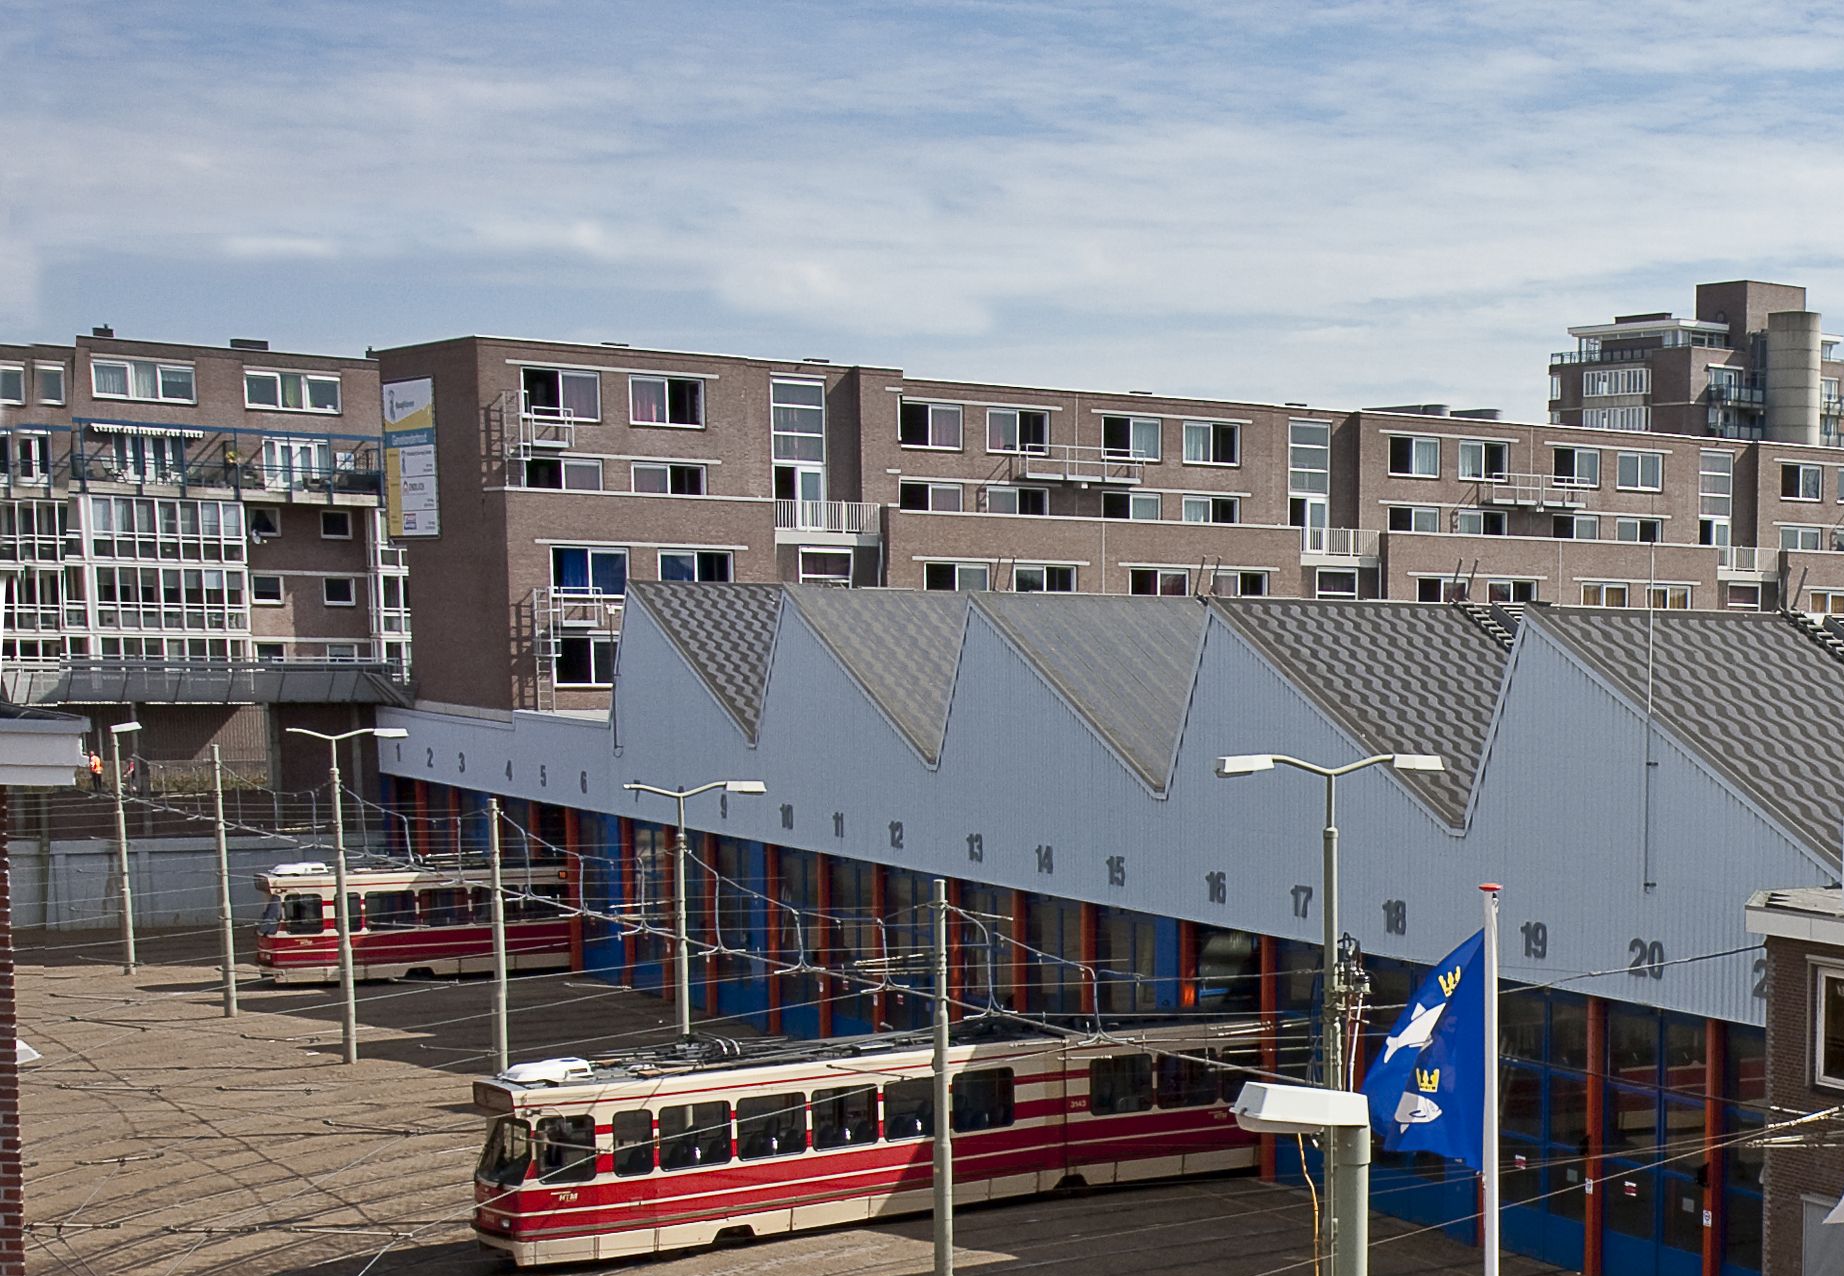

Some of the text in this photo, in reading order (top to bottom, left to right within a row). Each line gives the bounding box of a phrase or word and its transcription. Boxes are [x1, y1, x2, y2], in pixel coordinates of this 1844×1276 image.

[396, 743, 401, 762] 1
[426, 747, 434, 768] 2
[458, 752, 466, 773] 3
[505, 760, 513, 781] 4
[540, 765, 547, 787] 5
[580, 771, 588, 794] 6
[720, 793, 728, 819] 9
[779, 803, 794, 830] 10
[832, 811, 844, 838] 11
[888, 820, 904, 849] 12
[966, 833, 984, 863] 13
[1035, 844, 1054, 874] 14
[1105, 855, 1126, 887] 15
[1205, 871, 1227, 904] 16
[1290, 885, 1313, 919] 17
[1382, 899, 1407, 936] 18
[1520, 921, 1548, 960] 19
[1628, 938, 1665, 980] 20
